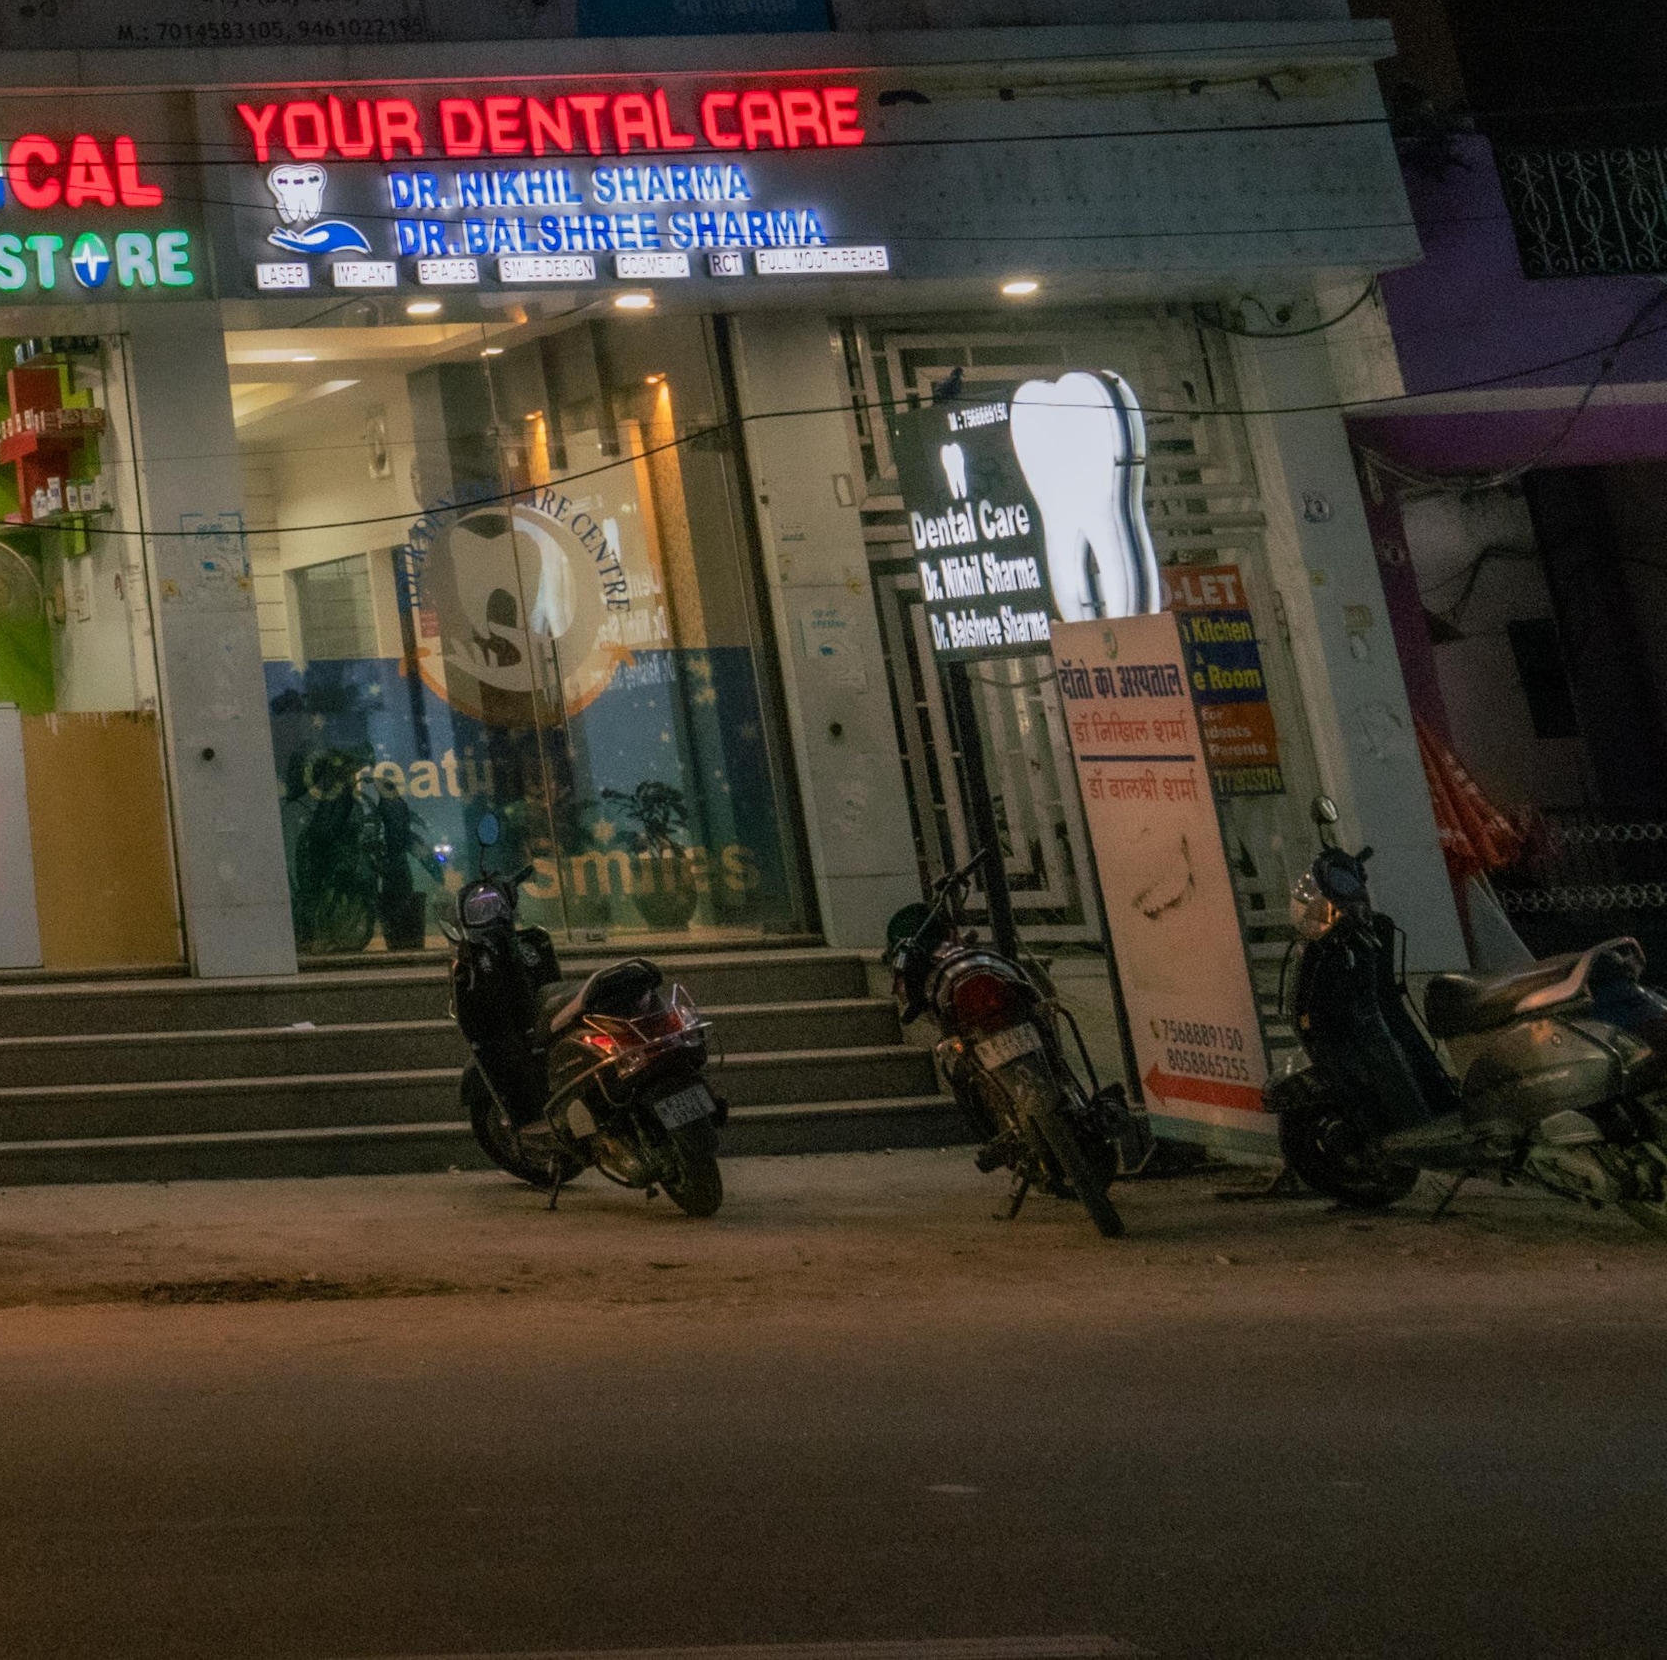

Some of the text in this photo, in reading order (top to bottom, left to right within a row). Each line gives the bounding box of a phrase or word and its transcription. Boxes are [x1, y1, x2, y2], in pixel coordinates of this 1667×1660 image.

[237, 87, 865, 162] YOUR DENTAL CARE
[456, 167, 582, 209] NIKHIL
[591, 163, 752, 206] SHARMA
[668, 208, 829, 251] SHARMA
[261, 249, 886, 285] LASER IMPLANT BRACES SMILE DESIGN COSMETIC RCT FULL MOUTH REHAB
[910, 498, 1030, 551] Dental Care
[571, 511, 632, 613] CENTRE
[919, 551, 1041, 601] Dr. Nikhil Sharma
[930, 604, 1051, 651] Dr. Balshree Sharma
[1191, 618, 1253, 642] Kitchen
[1092, 667, 1117, 698] का
[1209, 665, 1261, 689] Room
[1092, 711, 1149, 744] निखिल
[1153, 710, 1189, 743] शर्मा
[1163, 768, 1198, 802] शर्मा
[1161, 1019, 1243, 1052] 7568889150
[1167, 1048, 1250, 1081] 8058865255
